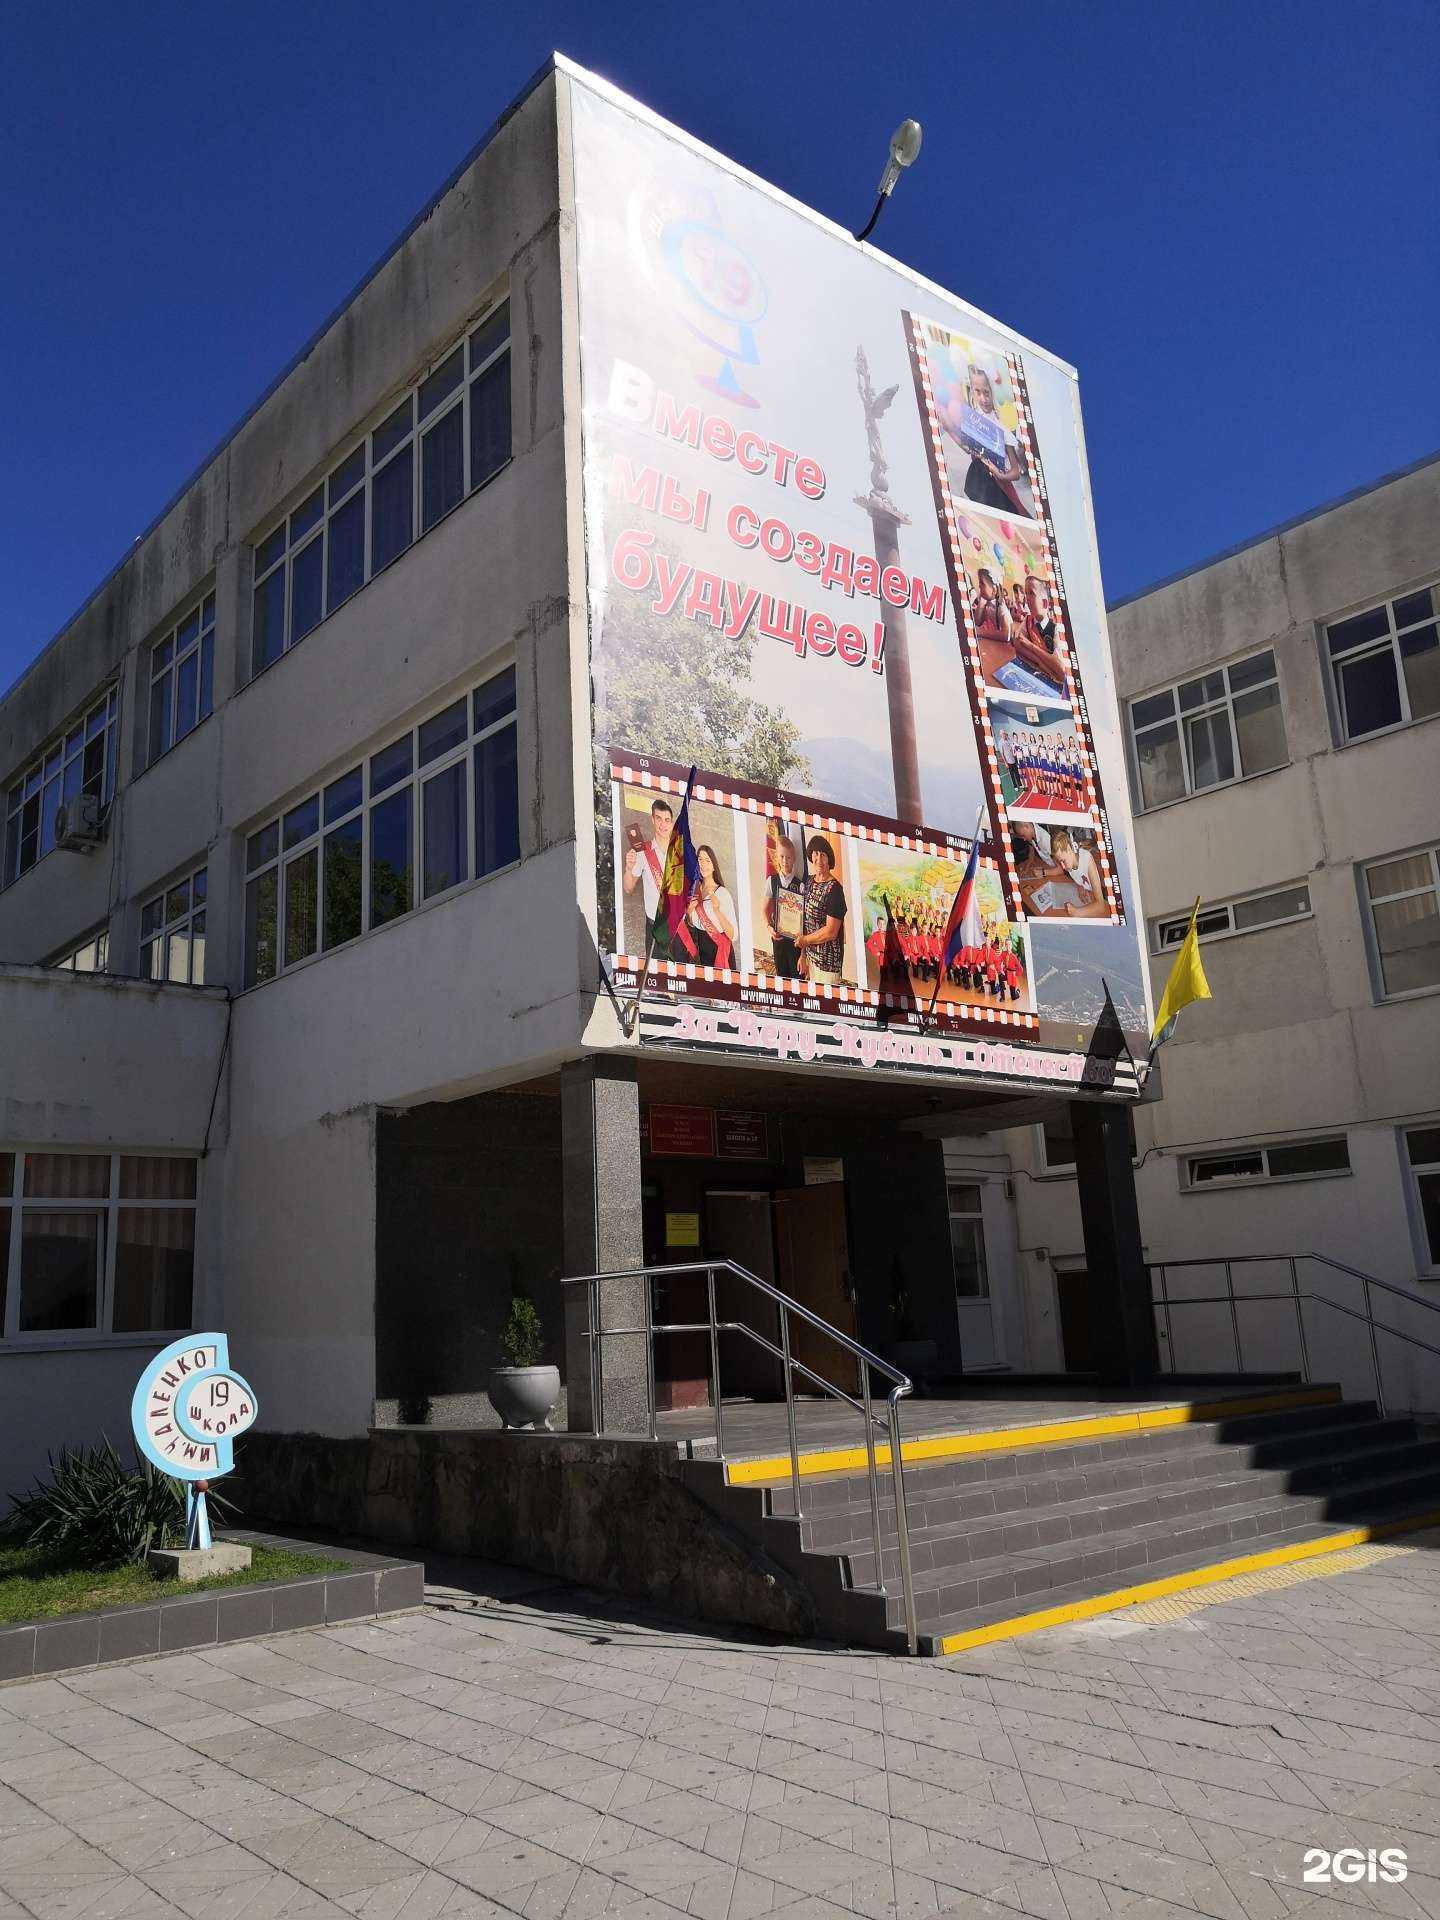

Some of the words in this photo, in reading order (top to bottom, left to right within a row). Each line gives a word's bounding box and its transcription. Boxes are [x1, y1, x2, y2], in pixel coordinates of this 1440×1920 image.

[608, 357, 827, 500] Вместе
[609, 455, 711, 529] мы
[726, 503, 946, 623] создаем
[612, 528, 886, 675] будущее!
[674, 1004, 717, 1041] За
[189, 1403, 249, 1434] ШКОЛА
[210, 1381, 230, 1407] 19
